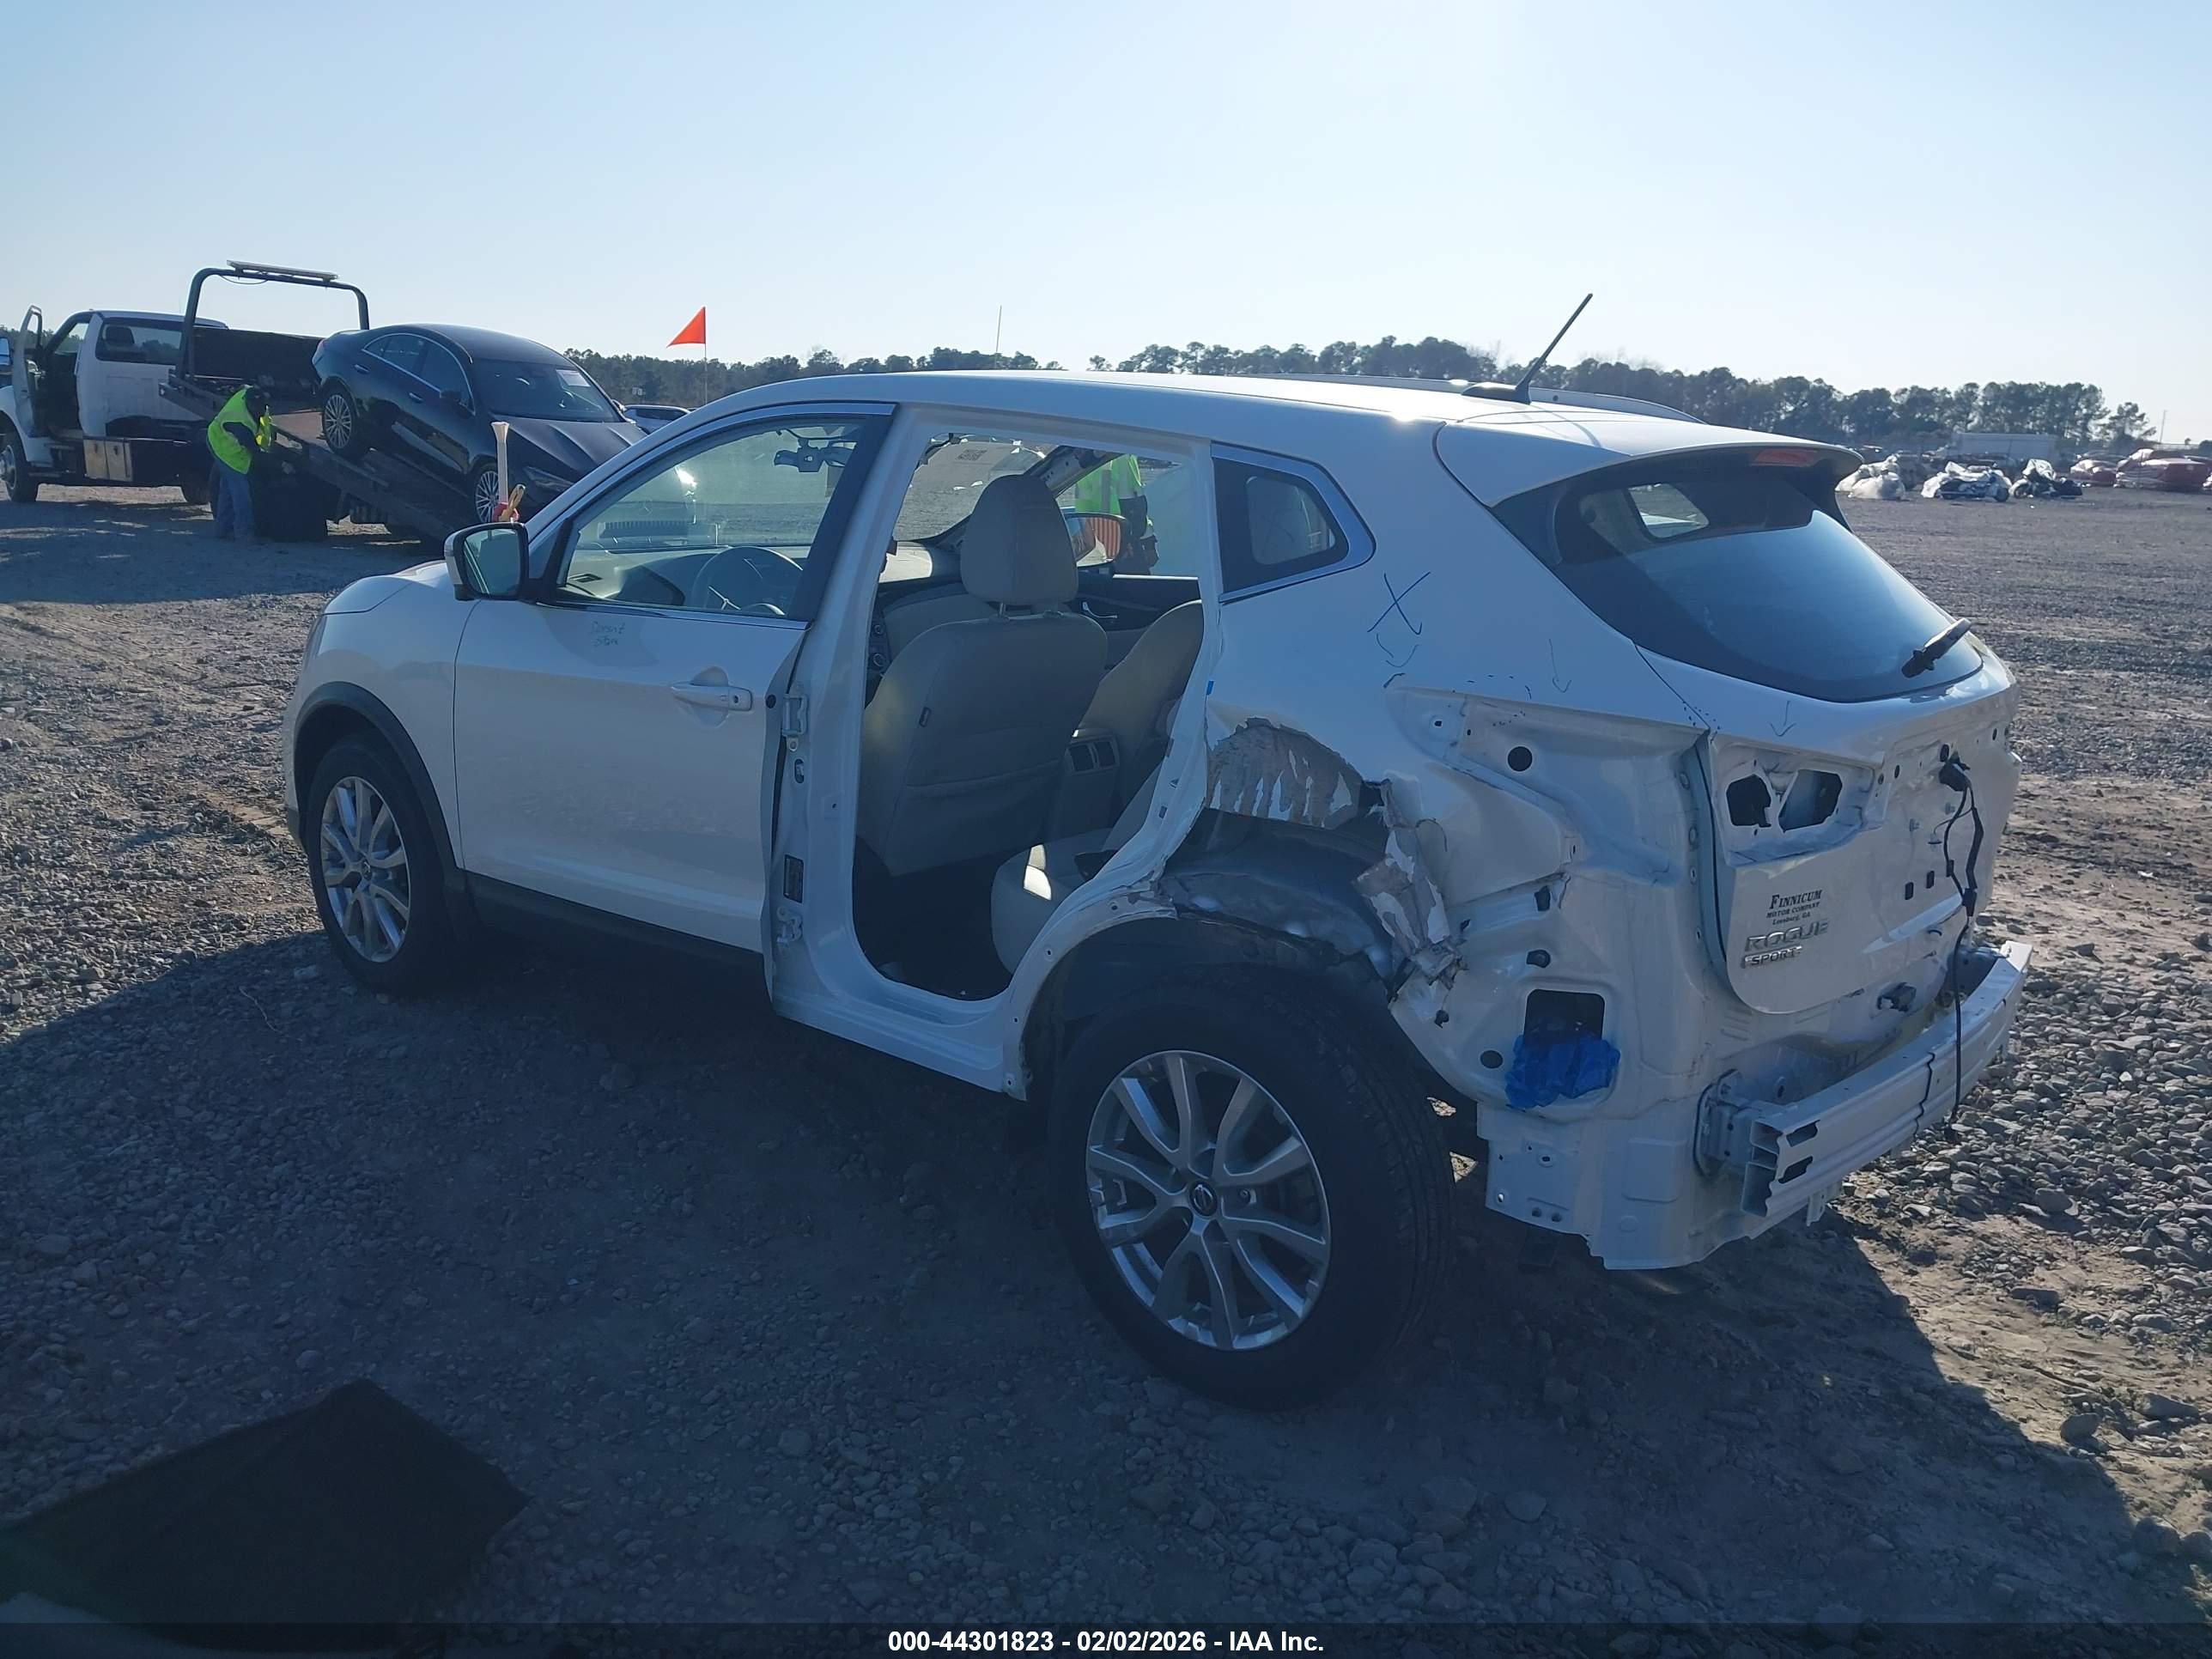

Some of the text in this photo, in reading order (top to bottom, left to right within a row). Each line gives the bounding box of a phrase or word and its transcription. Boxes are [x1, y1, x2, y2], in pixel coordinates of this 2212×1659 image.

[1765, 902, 1820, 918] MOTOR COMPANY
[1744, 919, 1828, 952] ROGUE
[1751, 947, 1797, 966] SPORT
